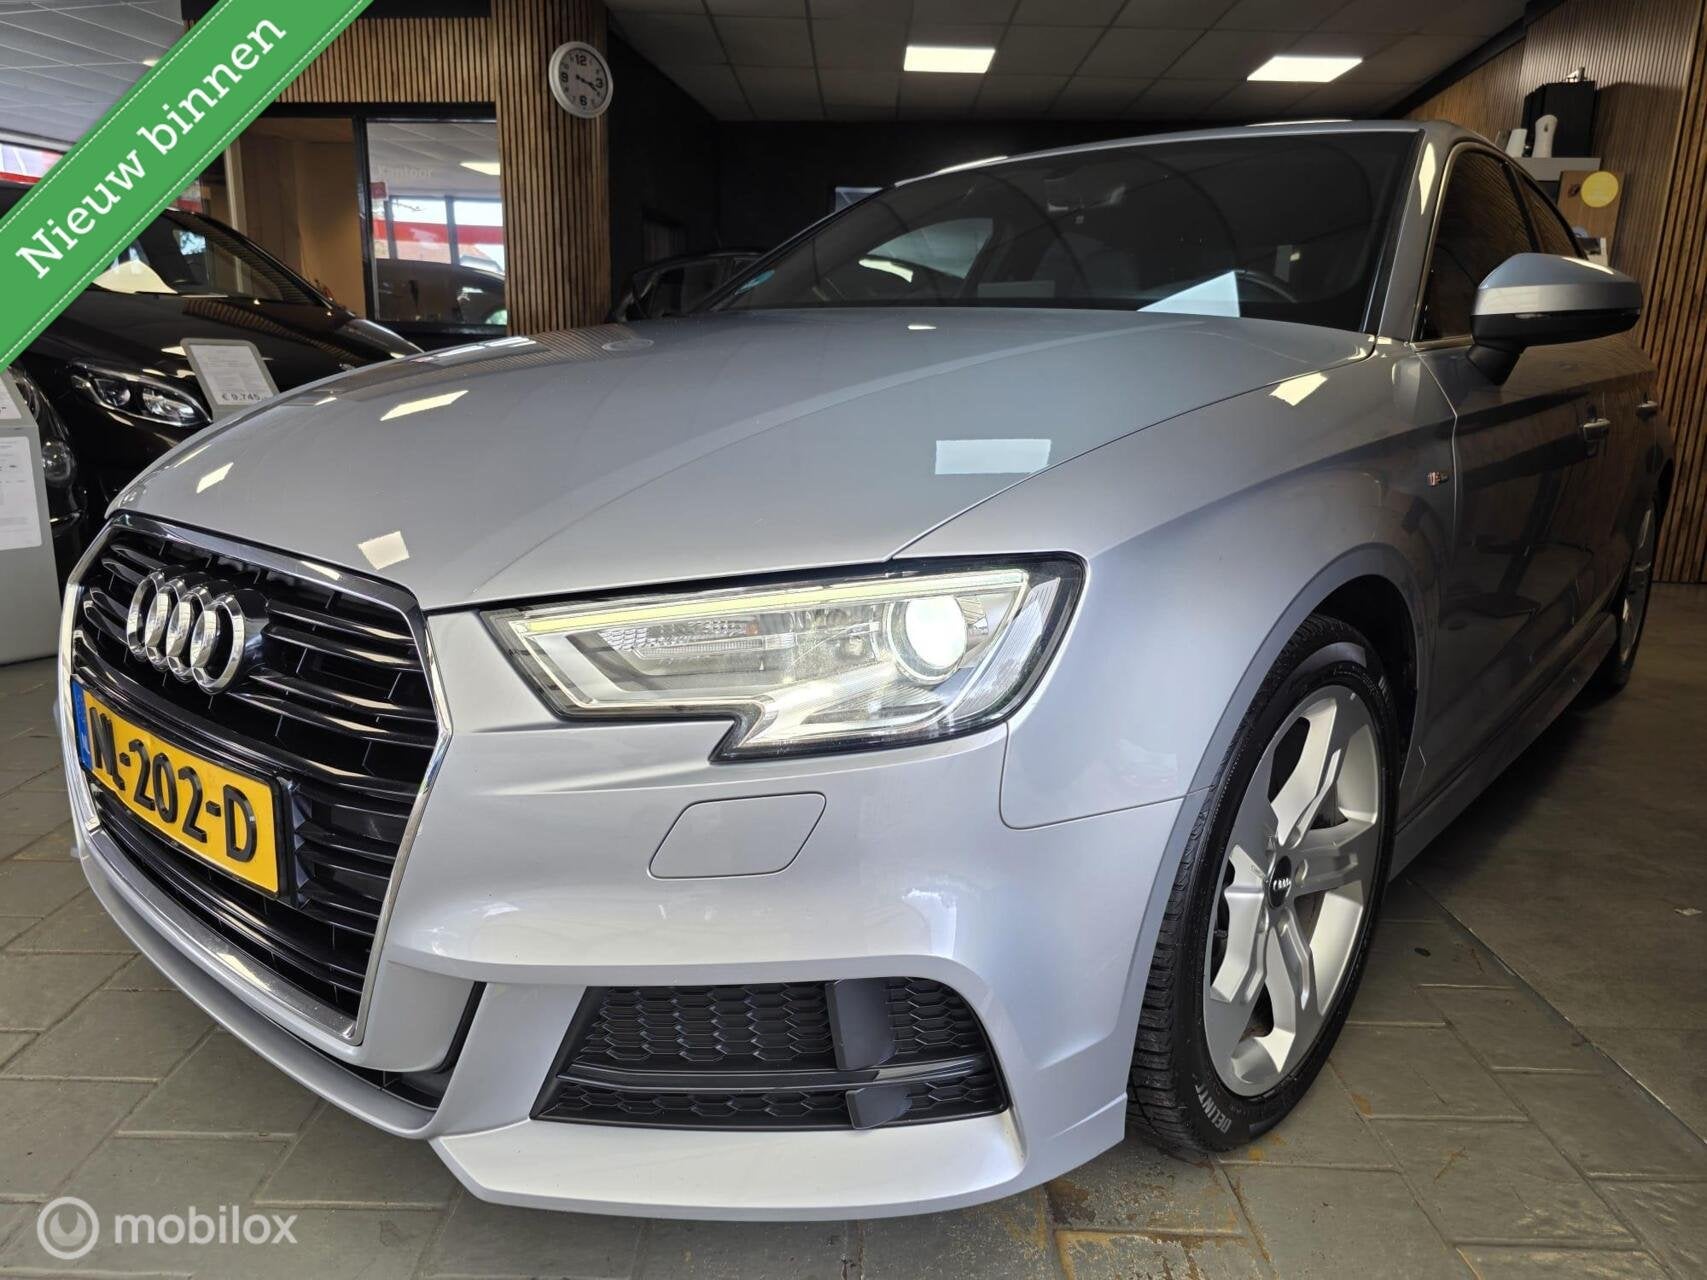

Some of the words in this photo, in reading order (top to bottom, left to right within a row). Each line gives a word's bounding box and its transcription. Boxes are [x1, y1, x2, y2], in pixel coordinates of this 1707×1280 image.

[575, 54, 587, 66] 12
[561, 72, 569, 83] 9
[595, 77, 603, 88] 3
